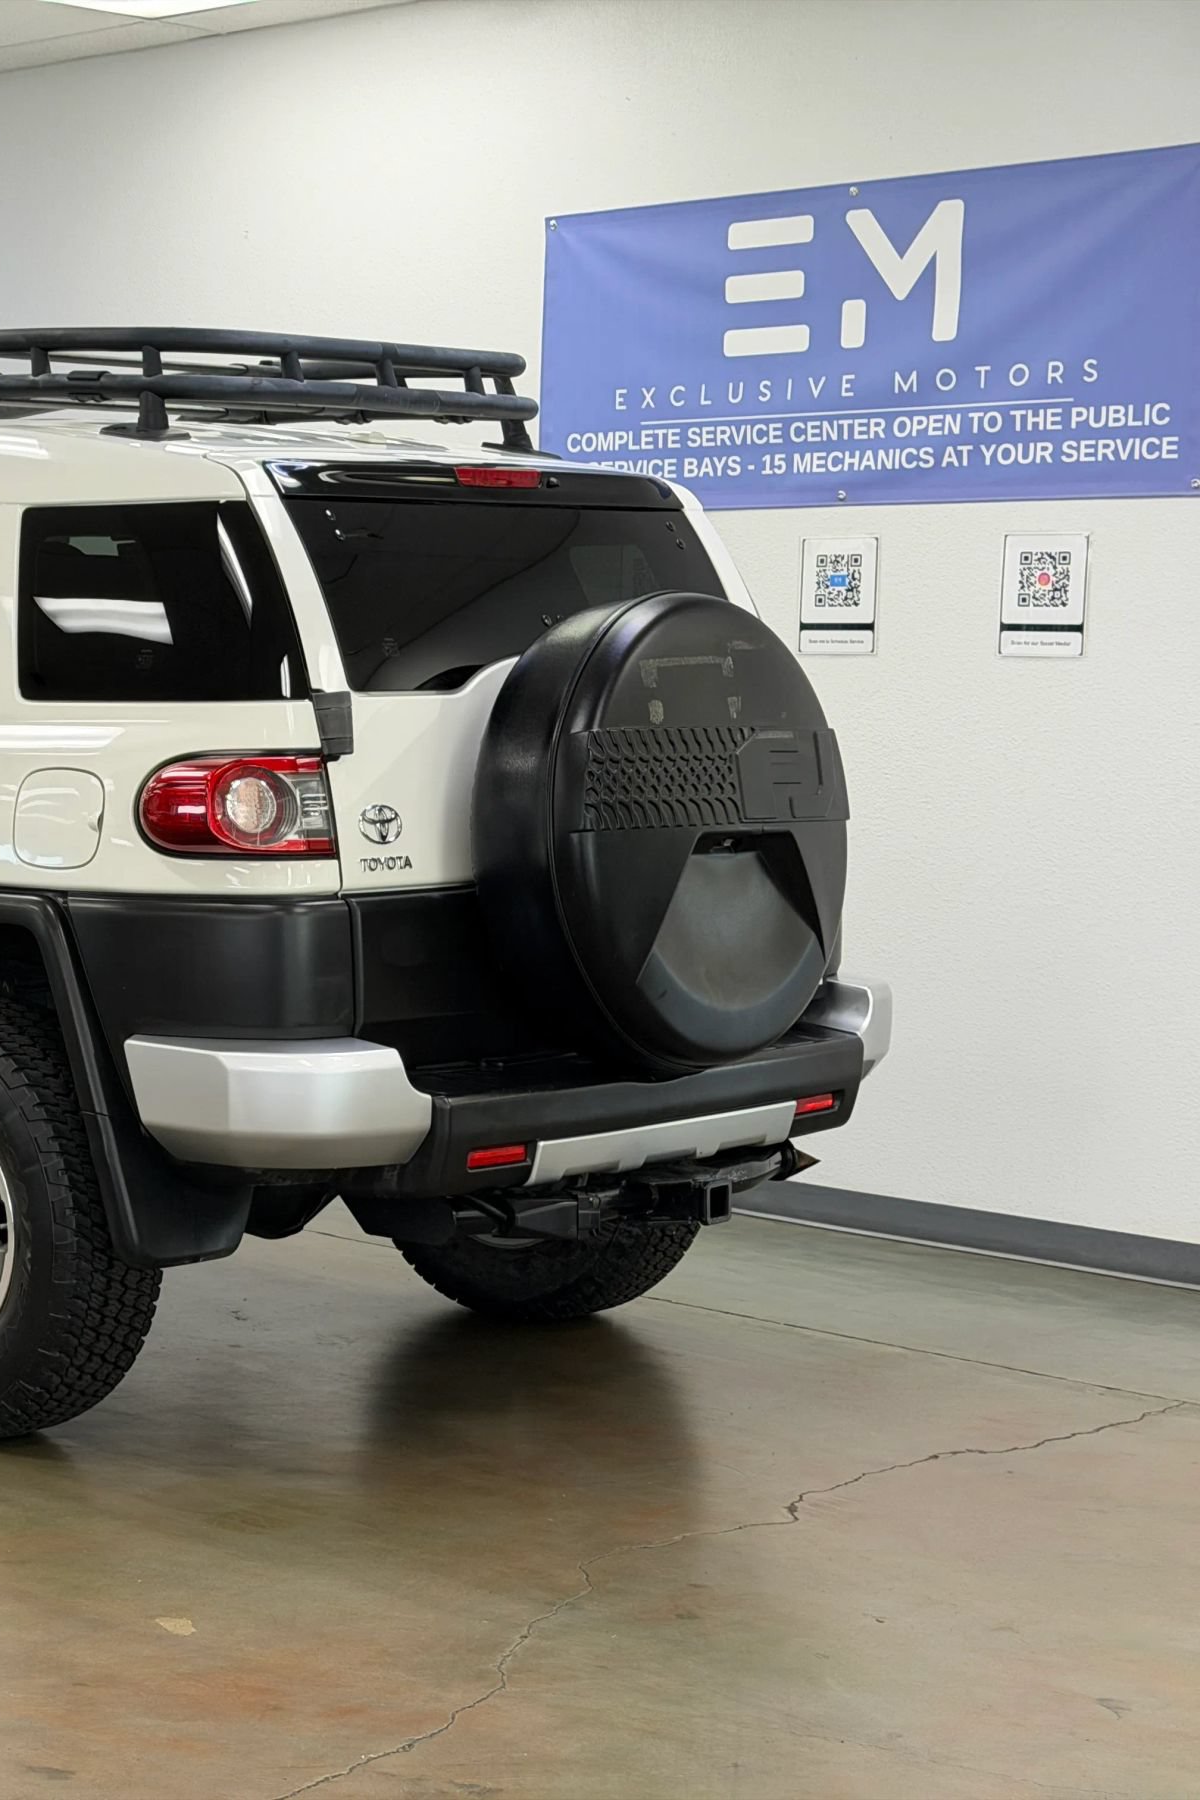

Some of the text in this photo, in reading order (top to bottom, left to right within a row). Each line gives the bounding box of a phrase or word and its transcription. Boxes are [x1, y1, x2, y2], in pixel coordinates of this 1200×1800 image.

[615, 358, 1099, 411] EXCLUSIVE MOTORS
[566, 402, 1171, 453] COMPLETE SERVICE CENTER OPEN TO THE PUBLIC
[588, 459, 678, 479] RVICE
[683, 456, 742, 478] BAYS
[762, 453, 788, 475] 15
[793, 447, 935, 473] MECHANICS
[941, 445, 973, 468] AT
[980, 442, 1055, 466] YOUR
[1061, 436, 1179, 463] SERVICE
[359, 855, 413, 872] TOYOTA
